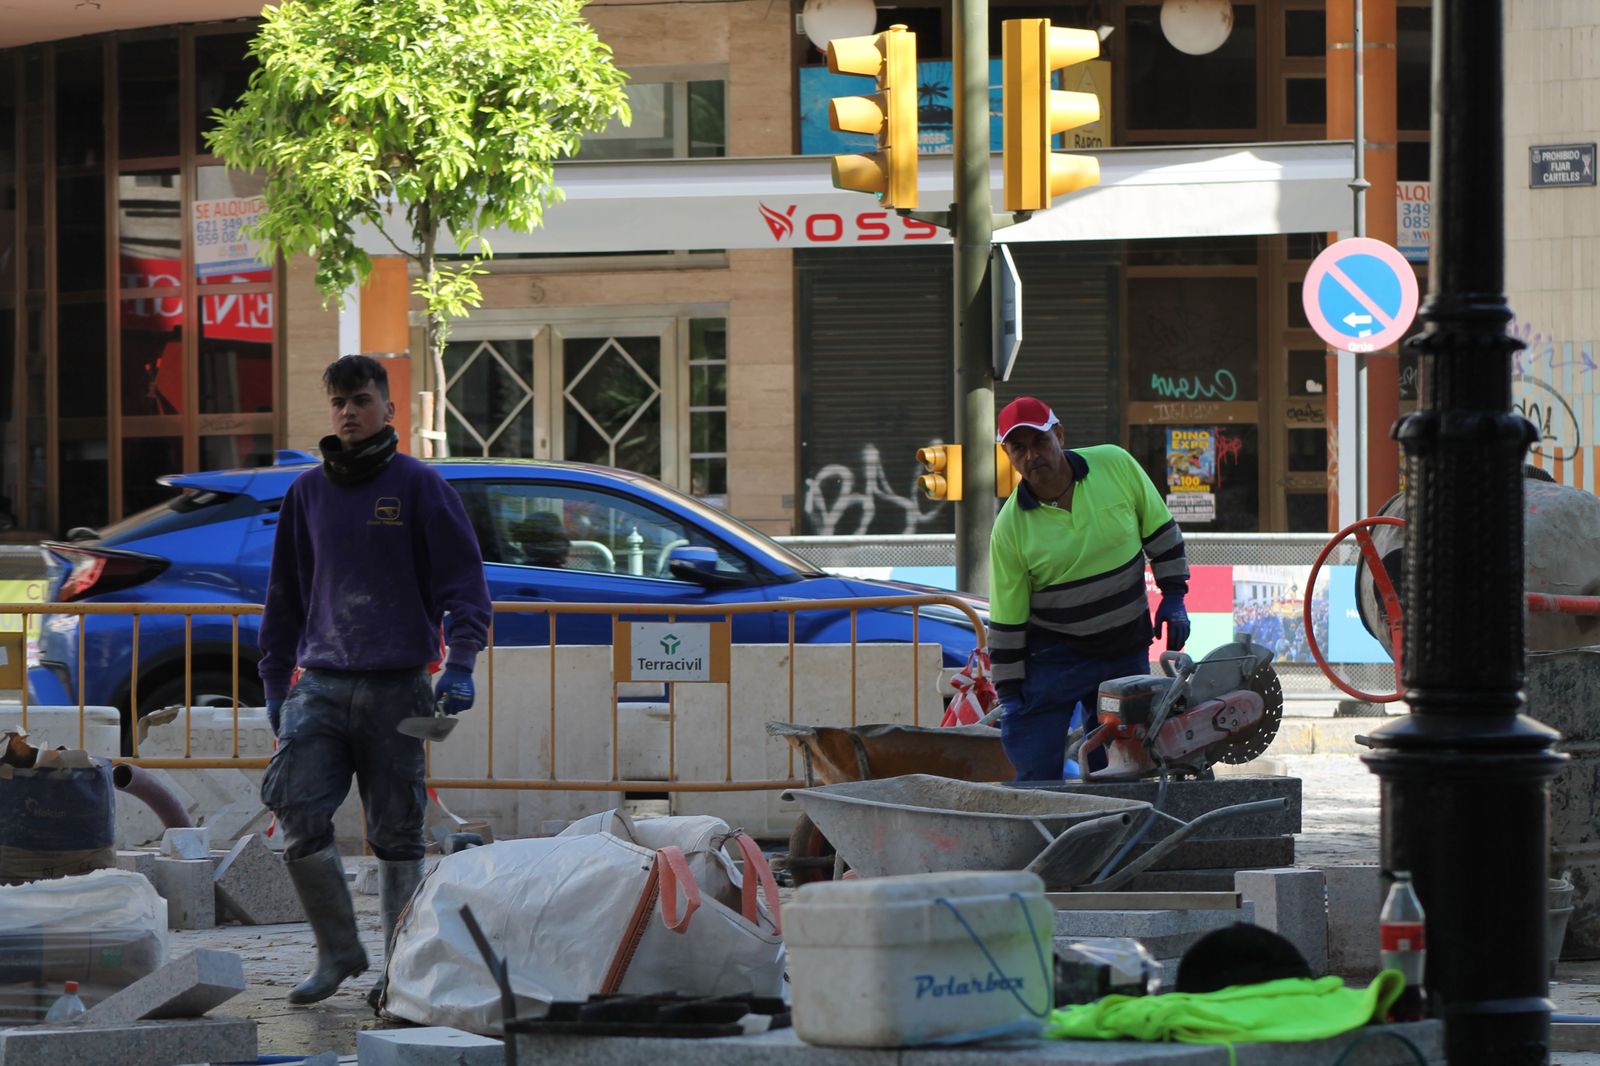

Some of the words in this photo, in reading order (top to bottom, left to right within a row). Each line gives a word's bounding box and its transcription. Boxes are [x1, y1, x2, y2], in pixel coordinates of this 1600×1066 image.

[1542, 150, 1580, 161] PROHIBIDO
[1550, 161, 1571, 172] FIJAR
[1543, 171, 1580, 183] CARTELES
[196, 203, 210, 220] SE
[1402, 203, 1431, 216] 349
[196, 220, 219, 234] 621
[223, 217, 243, 232] 349
[1402, 216, 1431, 229] 085
[197, 232, 219, 246] 959
[1171, 431, 1211, 440] DINO
[1171, 441, 1211, 450] EXPO
[1181, 475, 1201, 487] 100
[637, 657, 702, 671] Terracivil
[914, 971, 1025, 999] Polarbox
